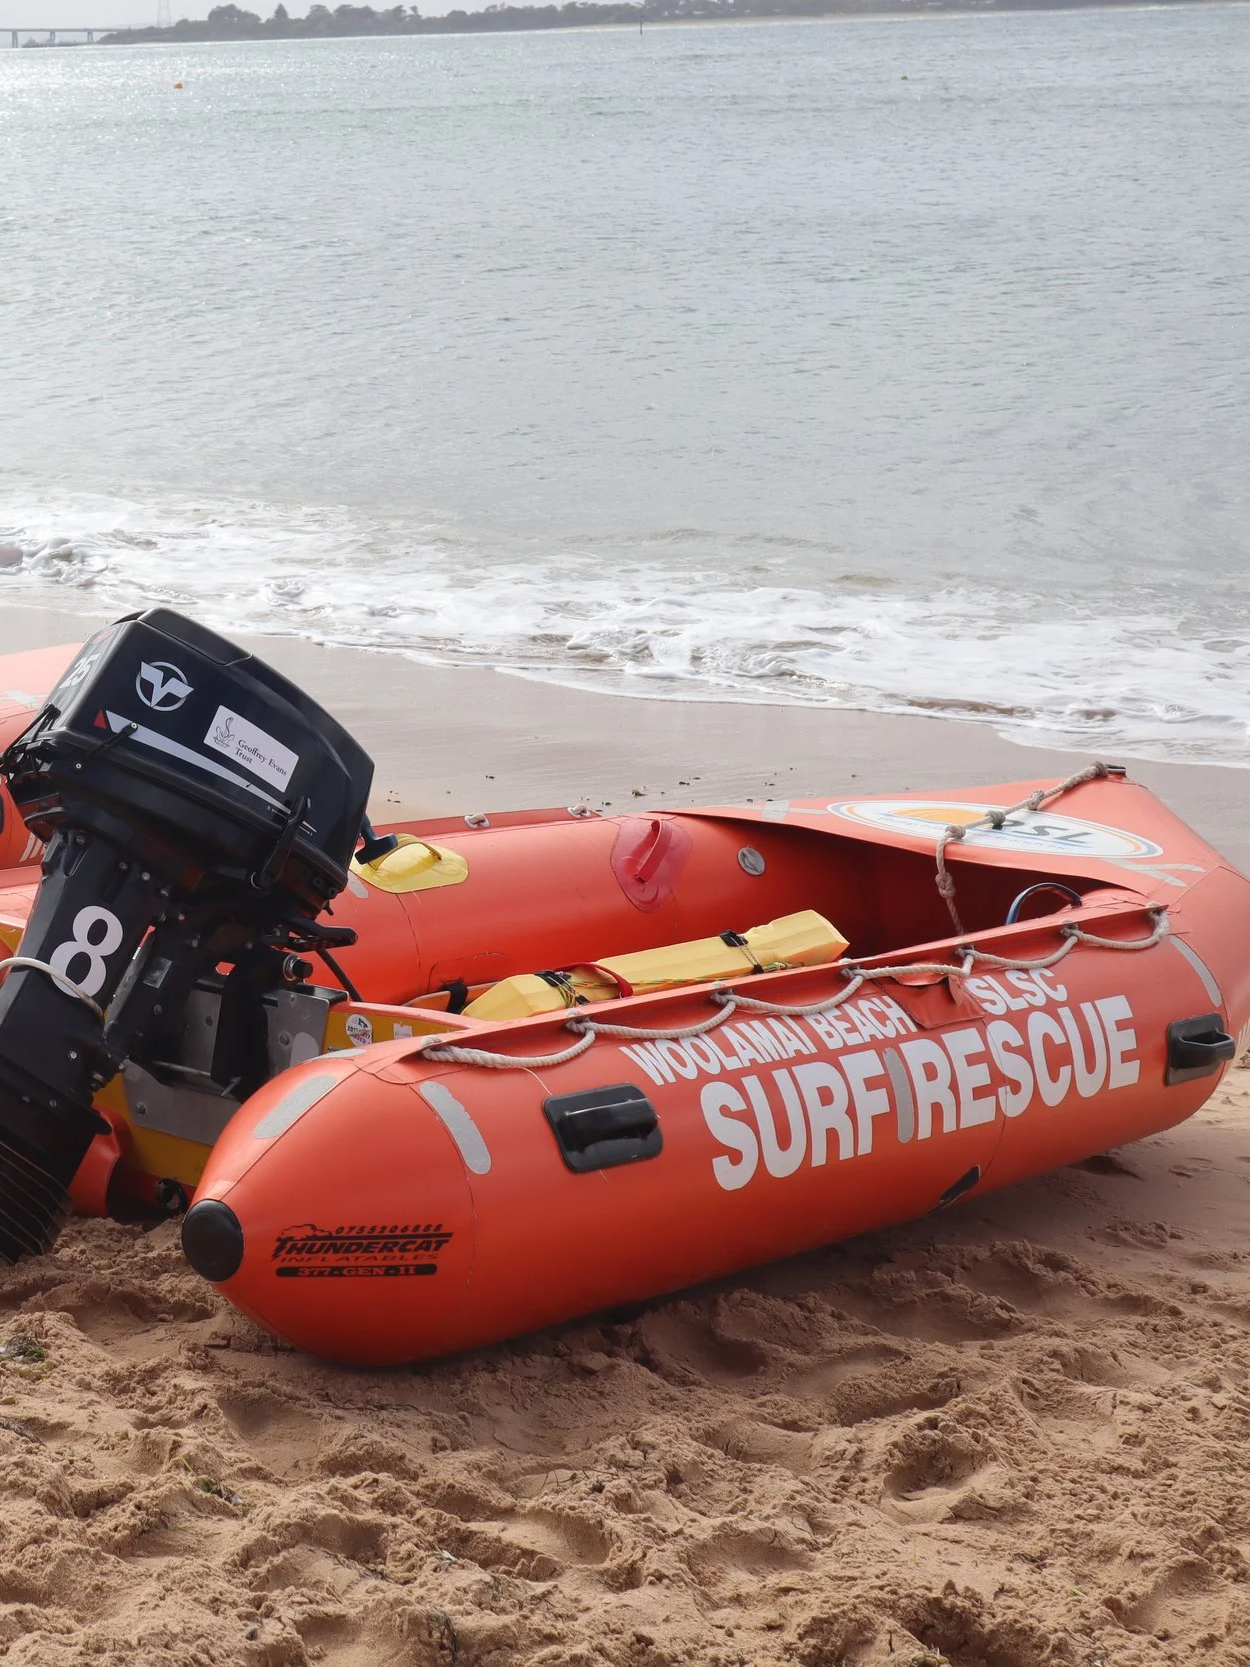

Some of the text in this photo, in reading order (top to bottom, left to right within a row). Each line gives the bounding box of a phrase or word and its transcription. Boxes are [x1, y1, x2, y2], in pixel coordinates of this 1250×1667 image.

[235, 747, 253, 764] Trust
[238, 739, 287, 776] Geoffrey Evans
[50, 905, 123, 998] 8
[618, 968, 1068, 1086] WOOLAMAI BEACH SLSC
[897, 995, 1142, 1140] RESCUE
[271, 1236, 450, 1261] THUNDERCAT
[280, 1253, 439, 1263] INFLATABLES
